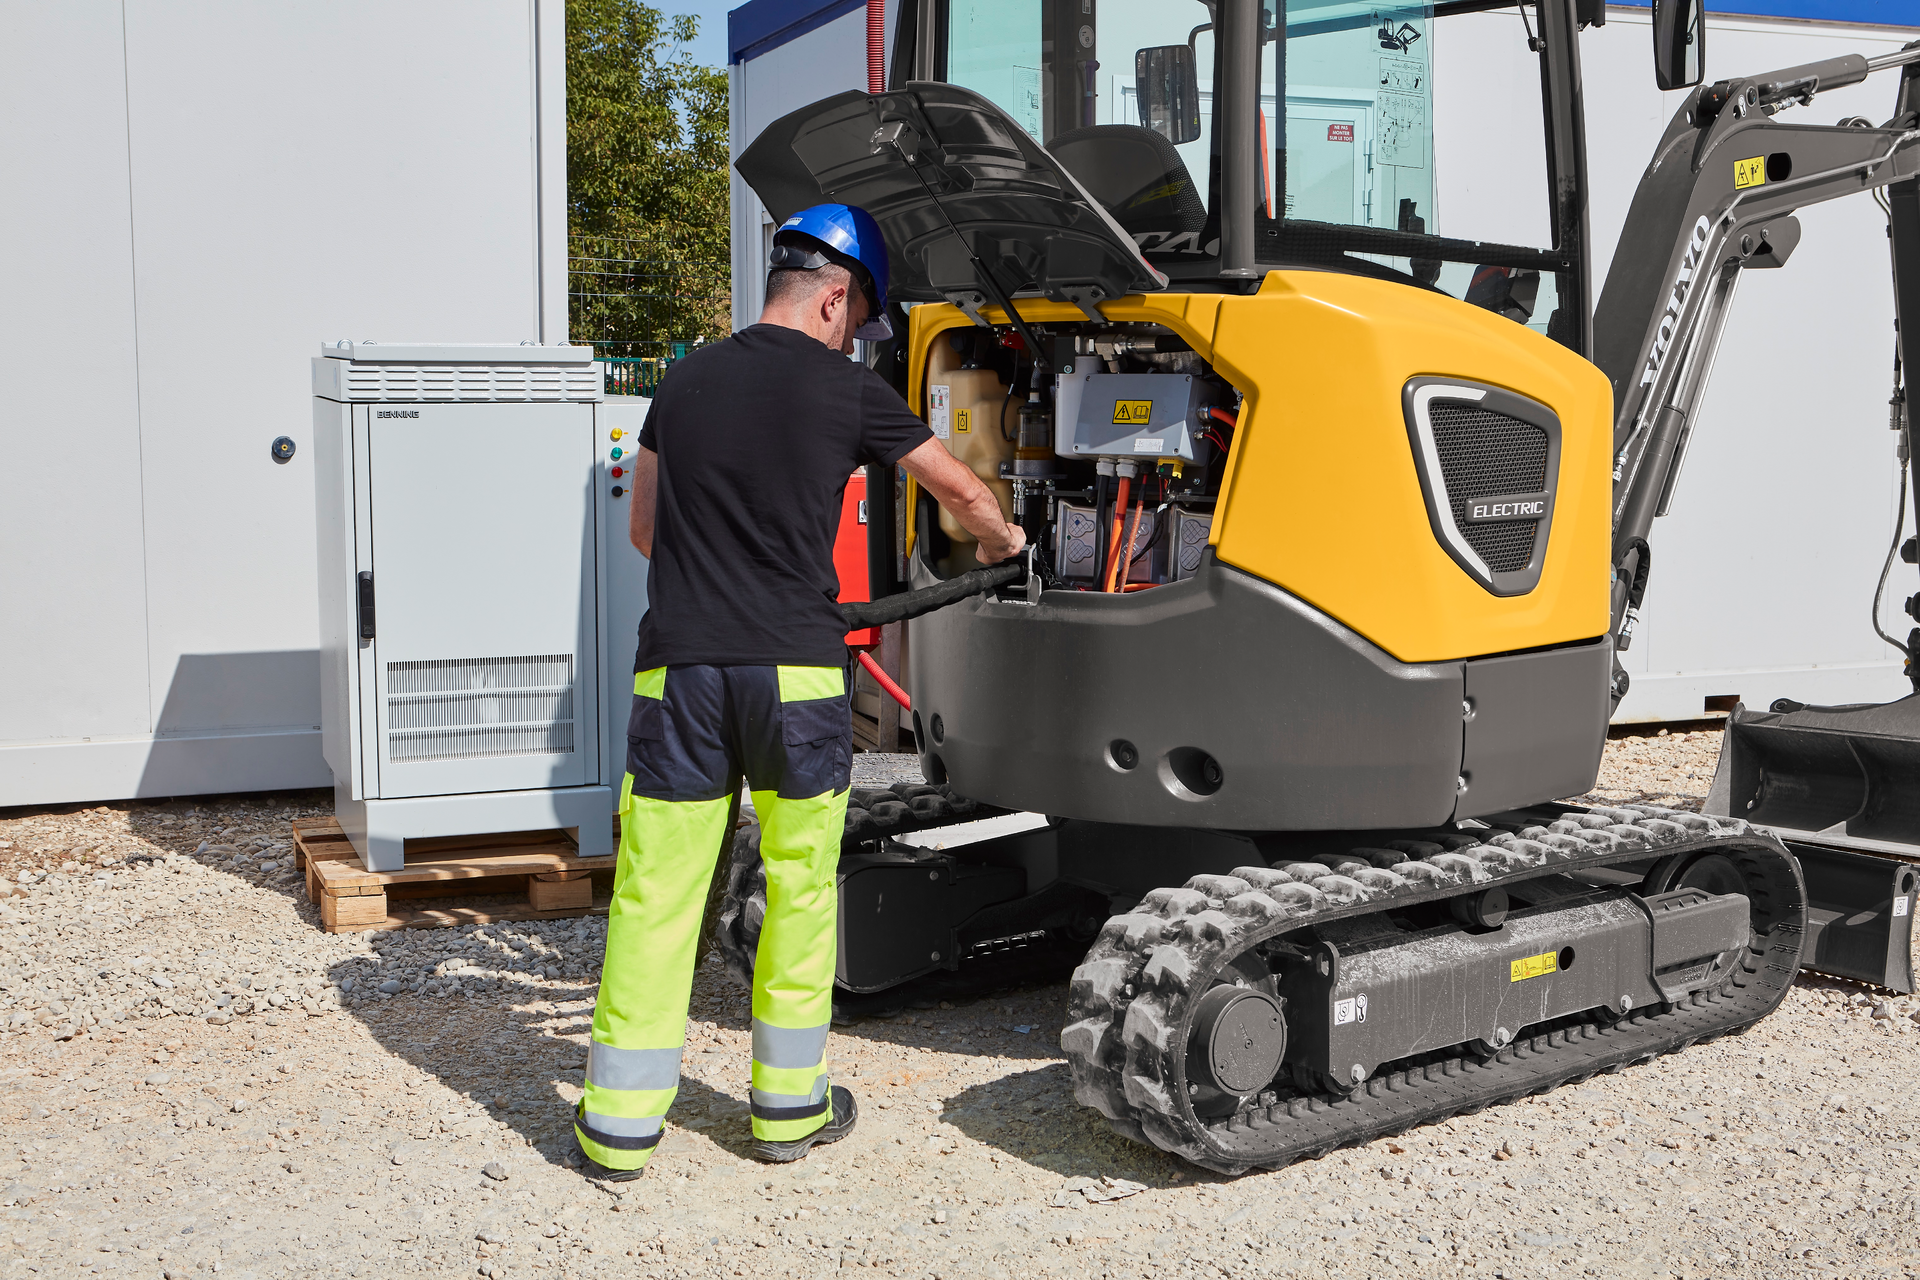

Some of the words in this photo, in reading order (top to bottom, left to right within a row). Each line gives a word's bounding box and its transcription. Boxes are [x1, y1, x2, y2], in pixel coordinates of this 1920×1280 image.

[1640, 215, 1710, 388] VOLVO
[377, 410, 420, 419] BENNING
[1473, 501, 1544, 518] ELECTRIC
